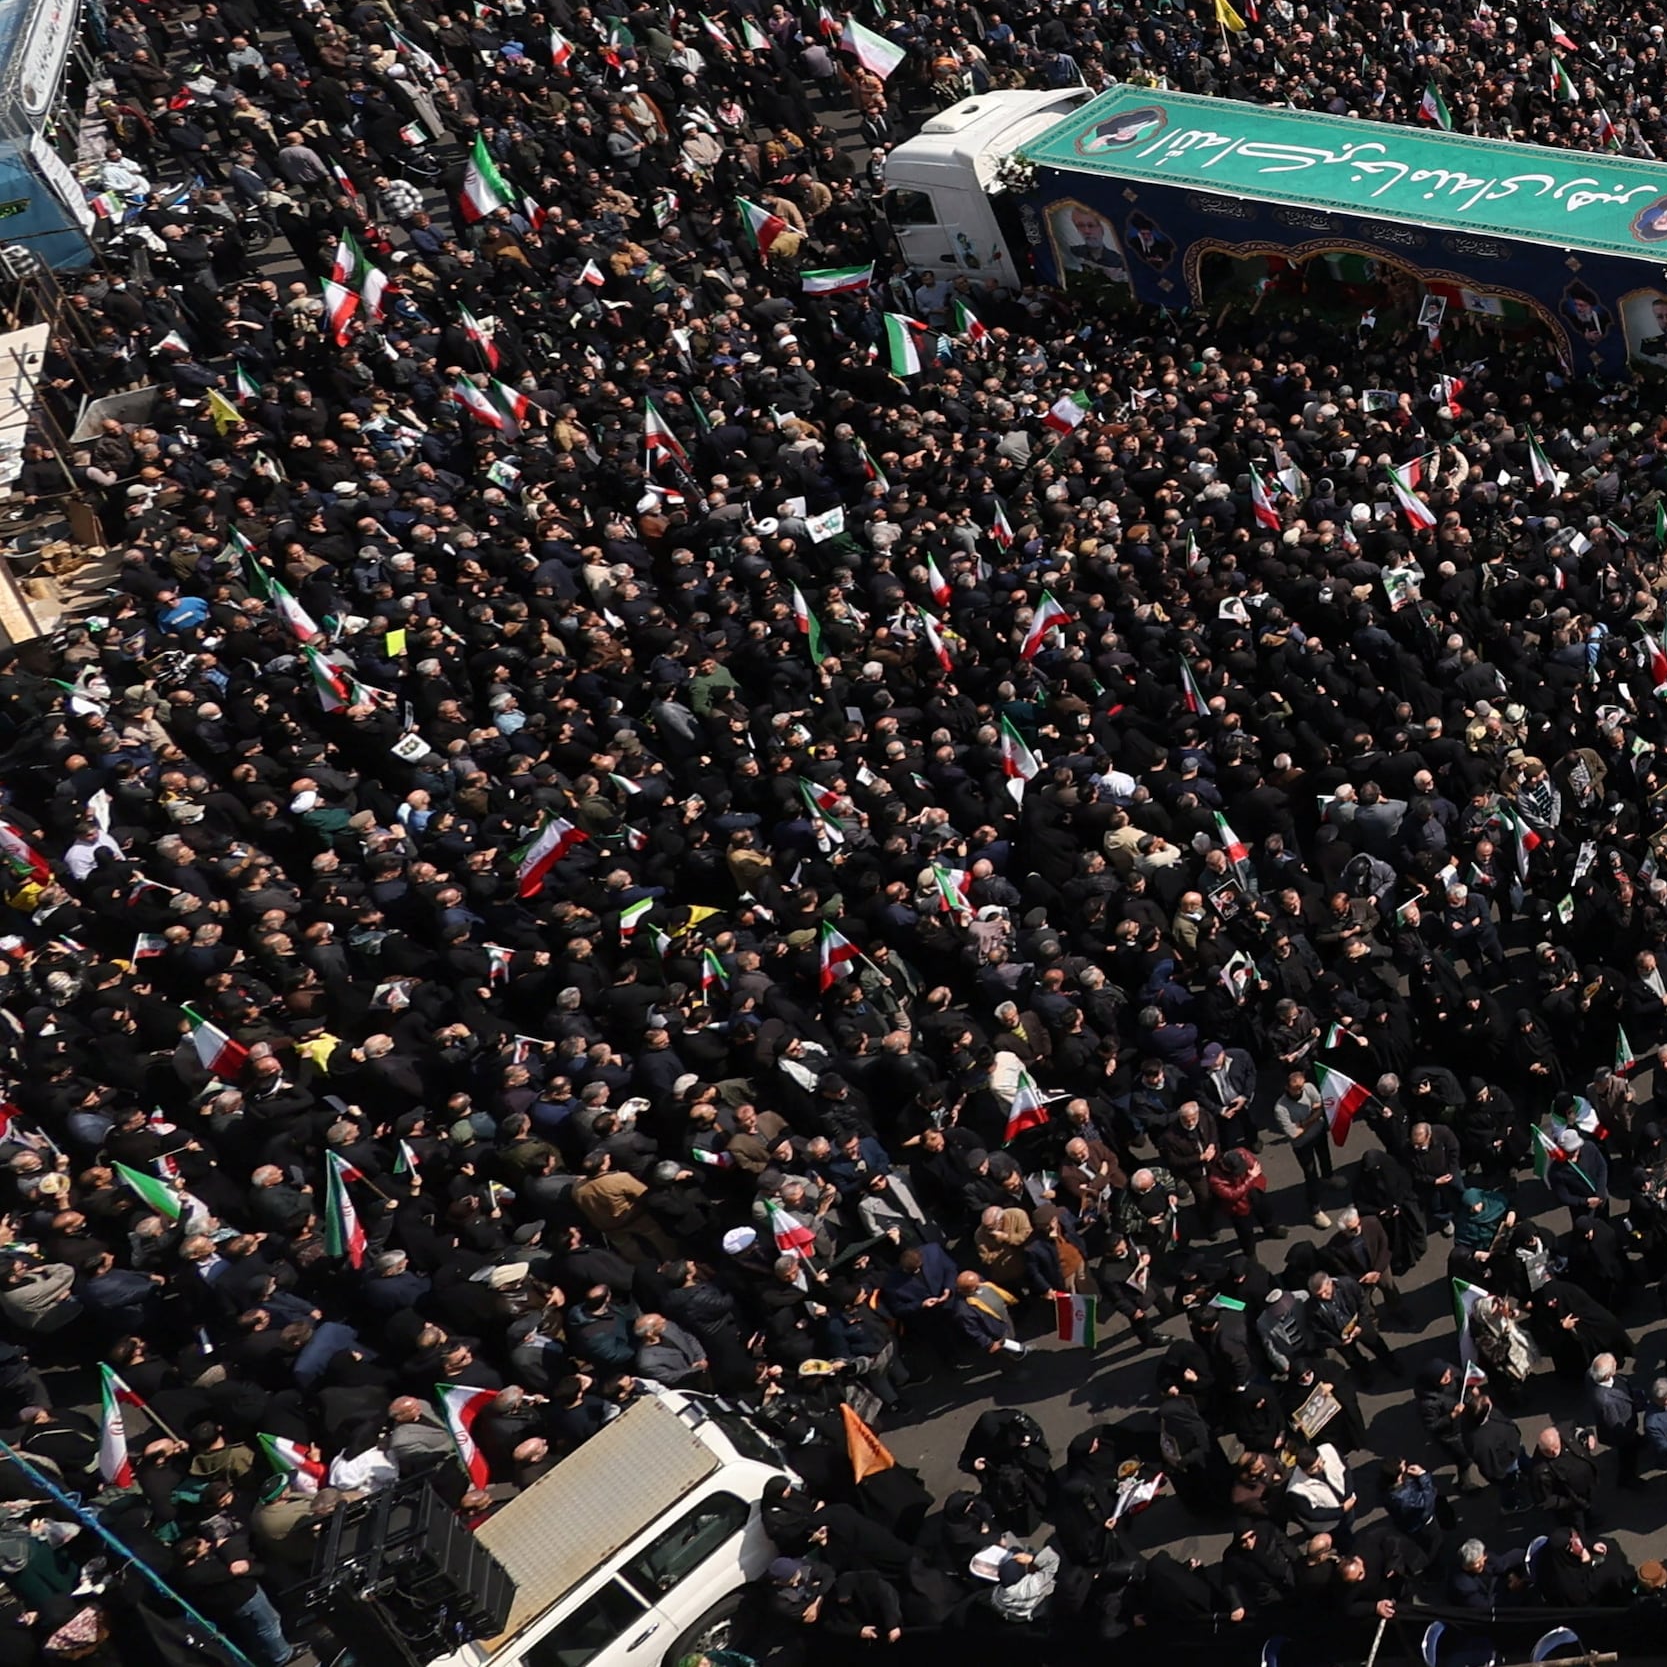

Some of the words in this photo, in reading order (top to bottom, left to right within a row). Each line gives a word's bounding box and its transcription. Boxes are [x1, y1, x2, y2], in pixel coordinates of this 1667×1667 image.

[1136, 127, 1232, 167] الله
[1202, 137, 1386, 174] اکبر
[1553, 177, 1658, 212] رهبر
